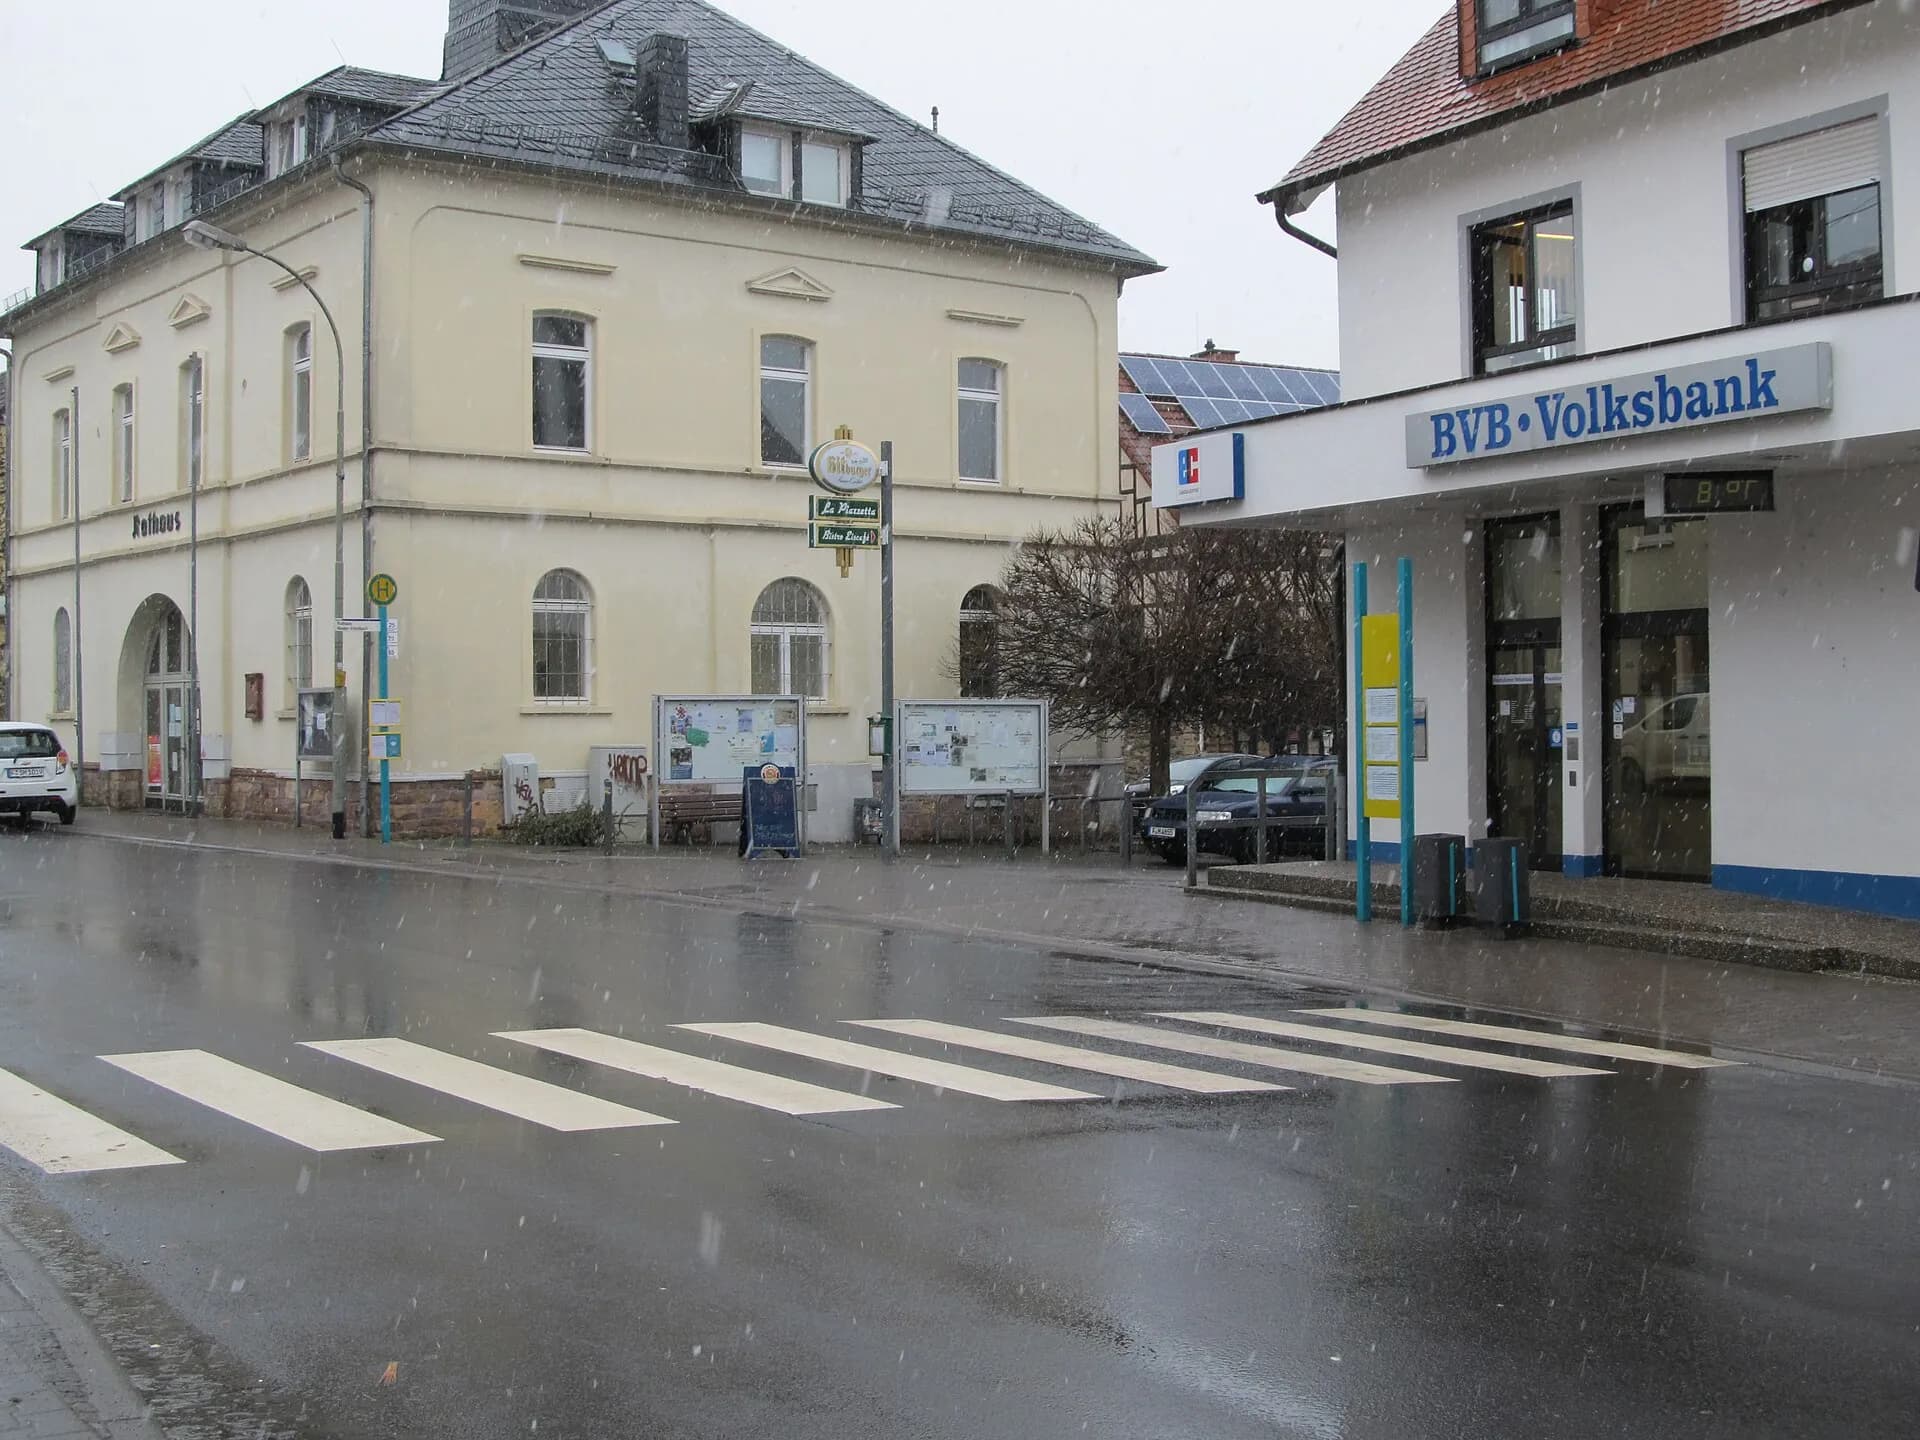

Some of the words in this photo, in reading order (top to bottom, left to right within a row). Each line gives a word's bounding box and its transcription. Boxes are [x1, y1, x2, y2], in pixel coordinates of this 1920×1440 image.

[1431, 402, 1511, 458] BVB
[1535, 359, 1779, 440] Volksbank
[820, 501, 835, 515] La
[837, 501, 876, 516] Piazzetta
[132, 511, 181, 539] Rathaus
[822, 527, 844, 541] Bistro
[377, 581, 389, 598] H
